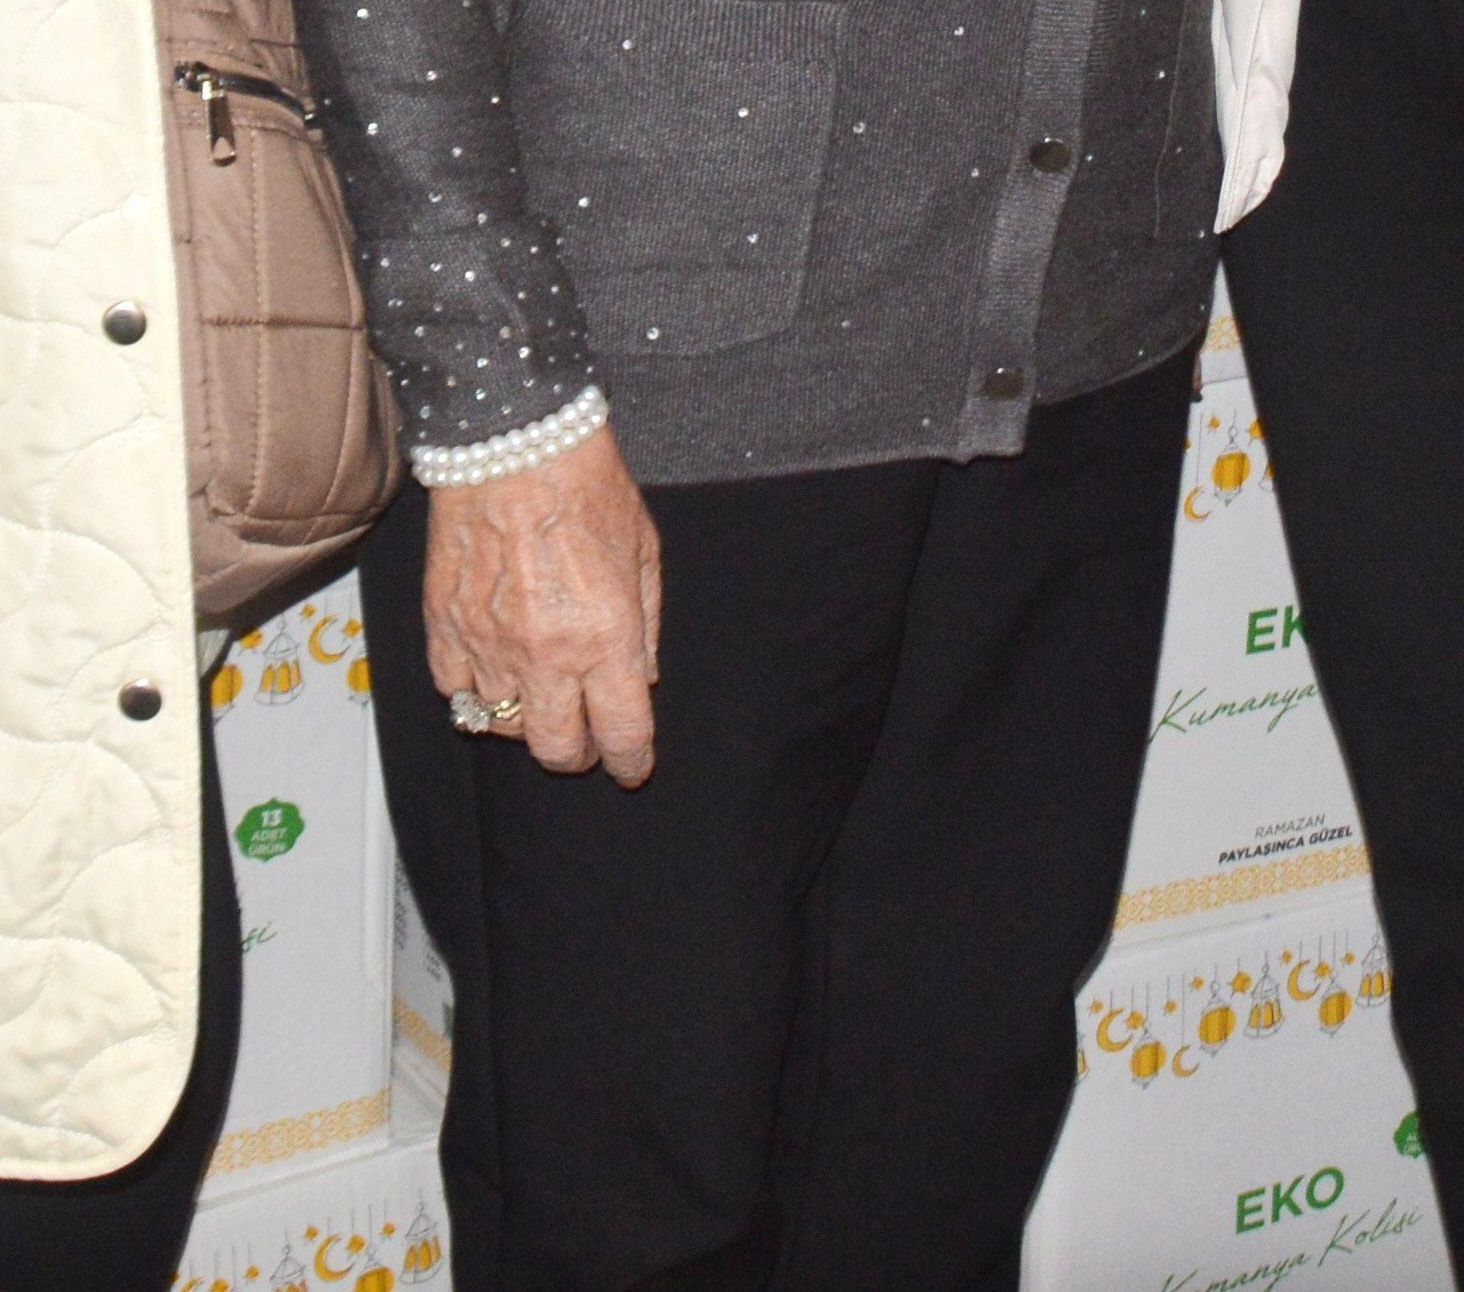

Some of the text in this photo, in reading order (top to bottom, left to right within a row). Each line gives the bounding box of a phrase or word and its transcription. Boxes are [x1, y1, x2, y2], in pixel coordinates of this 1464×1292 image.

[1246, 605, 1308, 655] EK
[1147, 684, 1324, 744] Kumanya
[251, 828, 287, 842] ADET
[260, 808, 284, 827] 13
[1254, 813, 1326, 840] RAMAZAN
[248, 841, 285, 857] ÜRÜN
[1218, 824, 1353, 866] PAYLAŞINCA GÜZEL
[1236, 1166, 1345, 1235] EKO
[1158, 1196, 1424, 1292] Kmanya Kolisi
